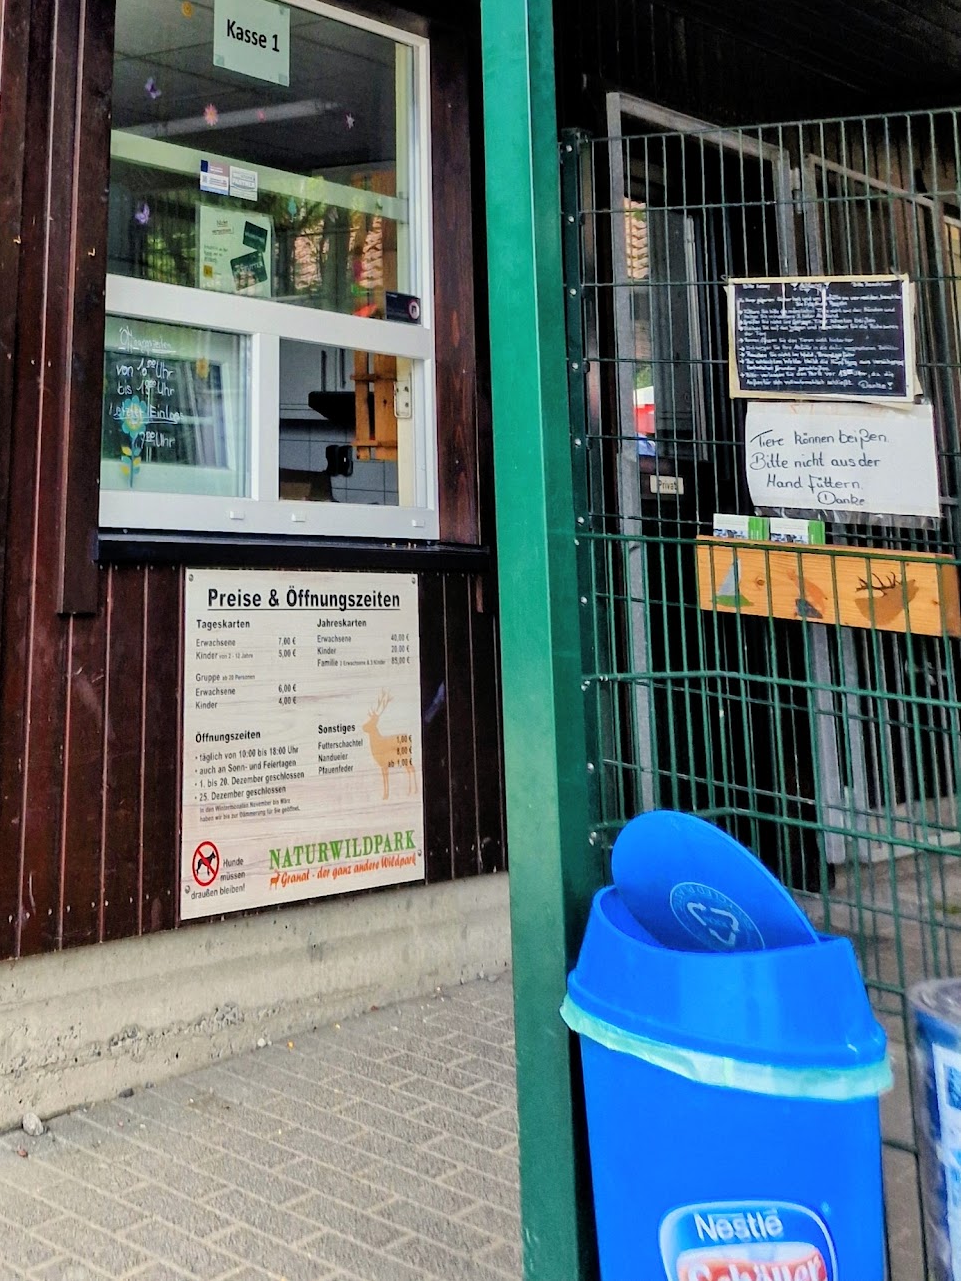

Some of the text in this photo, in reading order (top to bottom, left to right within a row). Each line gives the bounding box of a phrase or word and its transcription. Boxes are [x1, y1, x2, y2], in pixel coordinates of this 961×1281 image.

[226, 18, 280, 53] Kasse 1
[116, 364, 133, 378] von
[117, 380, 133, 395] bis
[750, 429, 784, 447] Tiere
[794, 430, 835, 445] können
[750, 451, 881, 470] Bitte nicht aus der
[766, 473, 803, 488] Hand
[817, 490, 865, 506] Danke
[208, 585, 400, 611] Preise & Öffnungszeiten
[196, 619, 251, 631] Tageskarten
[316, 618, 367, 628] Jahreskarten
[196, 638, 236, 647] Erwachsene
[317, 634, 352, 643] Erwachsene
[196, 651, 218, 660] Kinder
[317, 647, 336, 655] Kinder
[317, 658, 338, 667] Familie
[195, 673, 220, 683] Gruppe
[195, 684, 291, 697] Erwachsene 6,00
[195, 701, 218, 710] Kinder
[318, 724, 356, 735] Sonstiges
[195, 730, 261, 744] Öffnungszeiten
[318, 738, 364, 750] Futterschachtel
[199, 752, 223, 763] täglich
[257, 748, 267, 757] bis
[287, 745, 299, 754] Uhr
[199, 759, 297, 775] auch an Sonn- und Feiertagen
[318, 765, 354, 774] Pfauenfeder
[207, 779, 218, 788] bis
[231, 775, 264, 785] Dezember
[265, 771, 305, 784] geschlossen
[211, 789, 244, 801] Dezember
[245, 785, 286, 799] geschlossen
[269, 830, 416, 869] NATURWILDPARK
[222, 857, 244, 868] Hunde
[220, 871, 246, 882] müssen
[280, 852, 416, 888] Granat der ganz andere Wildpark
[191, 883, 245, 900] draußen bleiben!
